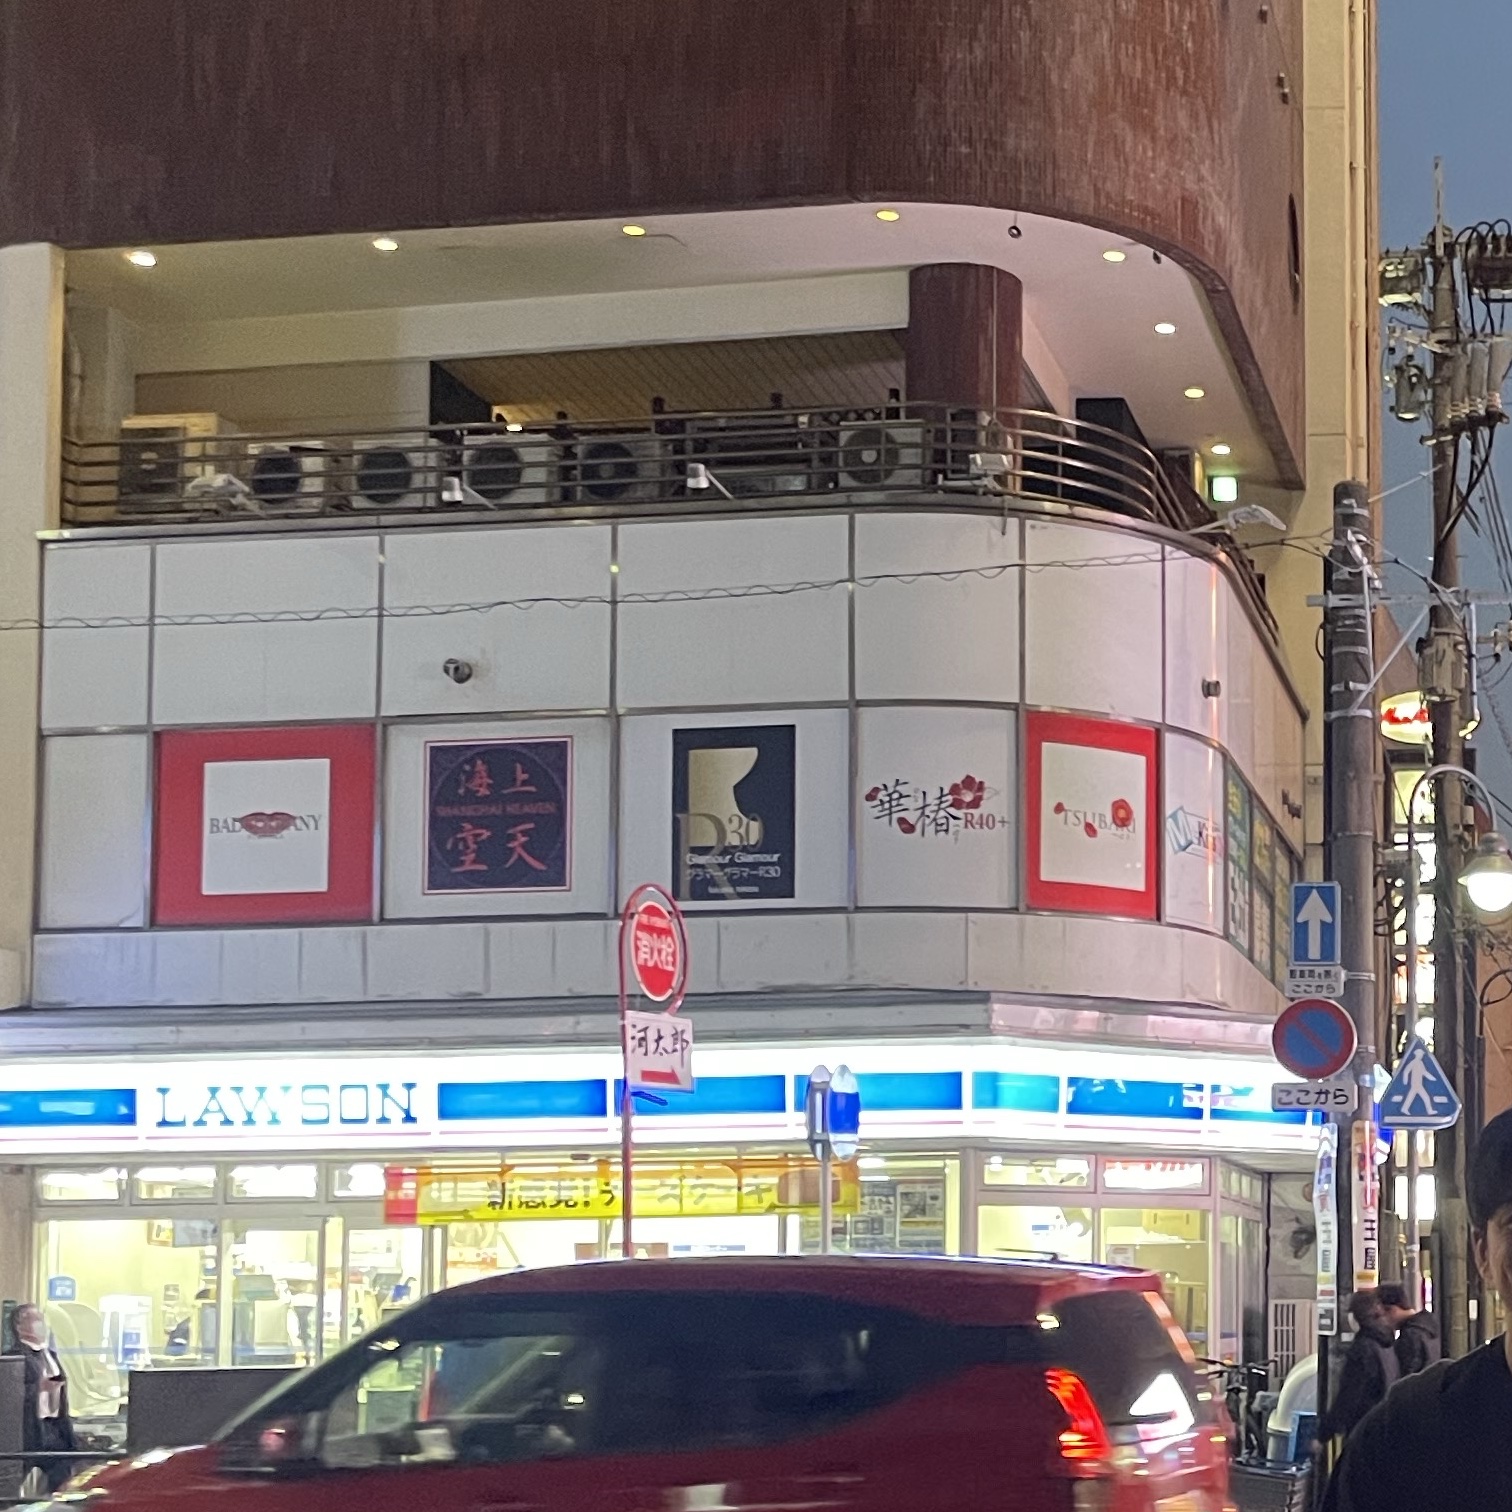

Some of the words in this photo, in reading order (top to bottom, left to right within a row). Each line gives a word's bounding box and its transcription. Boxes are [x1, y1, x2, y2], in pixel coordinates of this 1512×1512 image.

[636, 931, 675, 972] 消火栓
[1290, 983, 1337, 995] ここから
[630, 1023, 690, 1070] 河太郎
[155, 1082, 418, 1128] LAWSON
[1276, 1087, 1350, 1107] ここから
